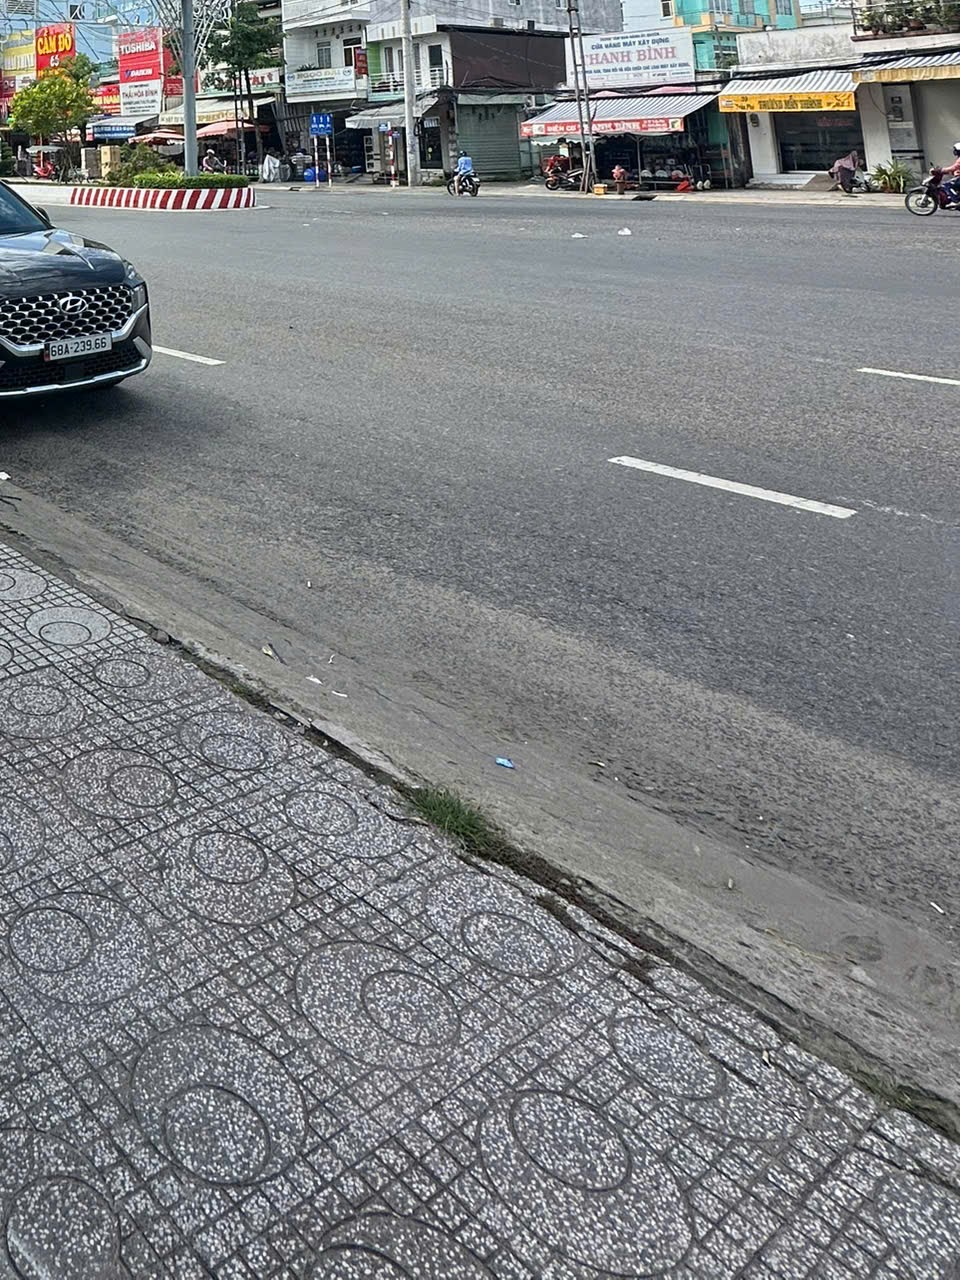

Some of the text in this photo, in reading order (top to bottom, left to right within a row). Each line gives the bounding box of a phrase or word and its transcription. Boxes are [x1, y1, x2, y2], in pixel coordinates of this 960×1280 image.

[120, 41, 157, 55] TOSHIBA
[636, 45, 677, 62] BÌNH
[50, 337, 107, 357] 68A-239.66
